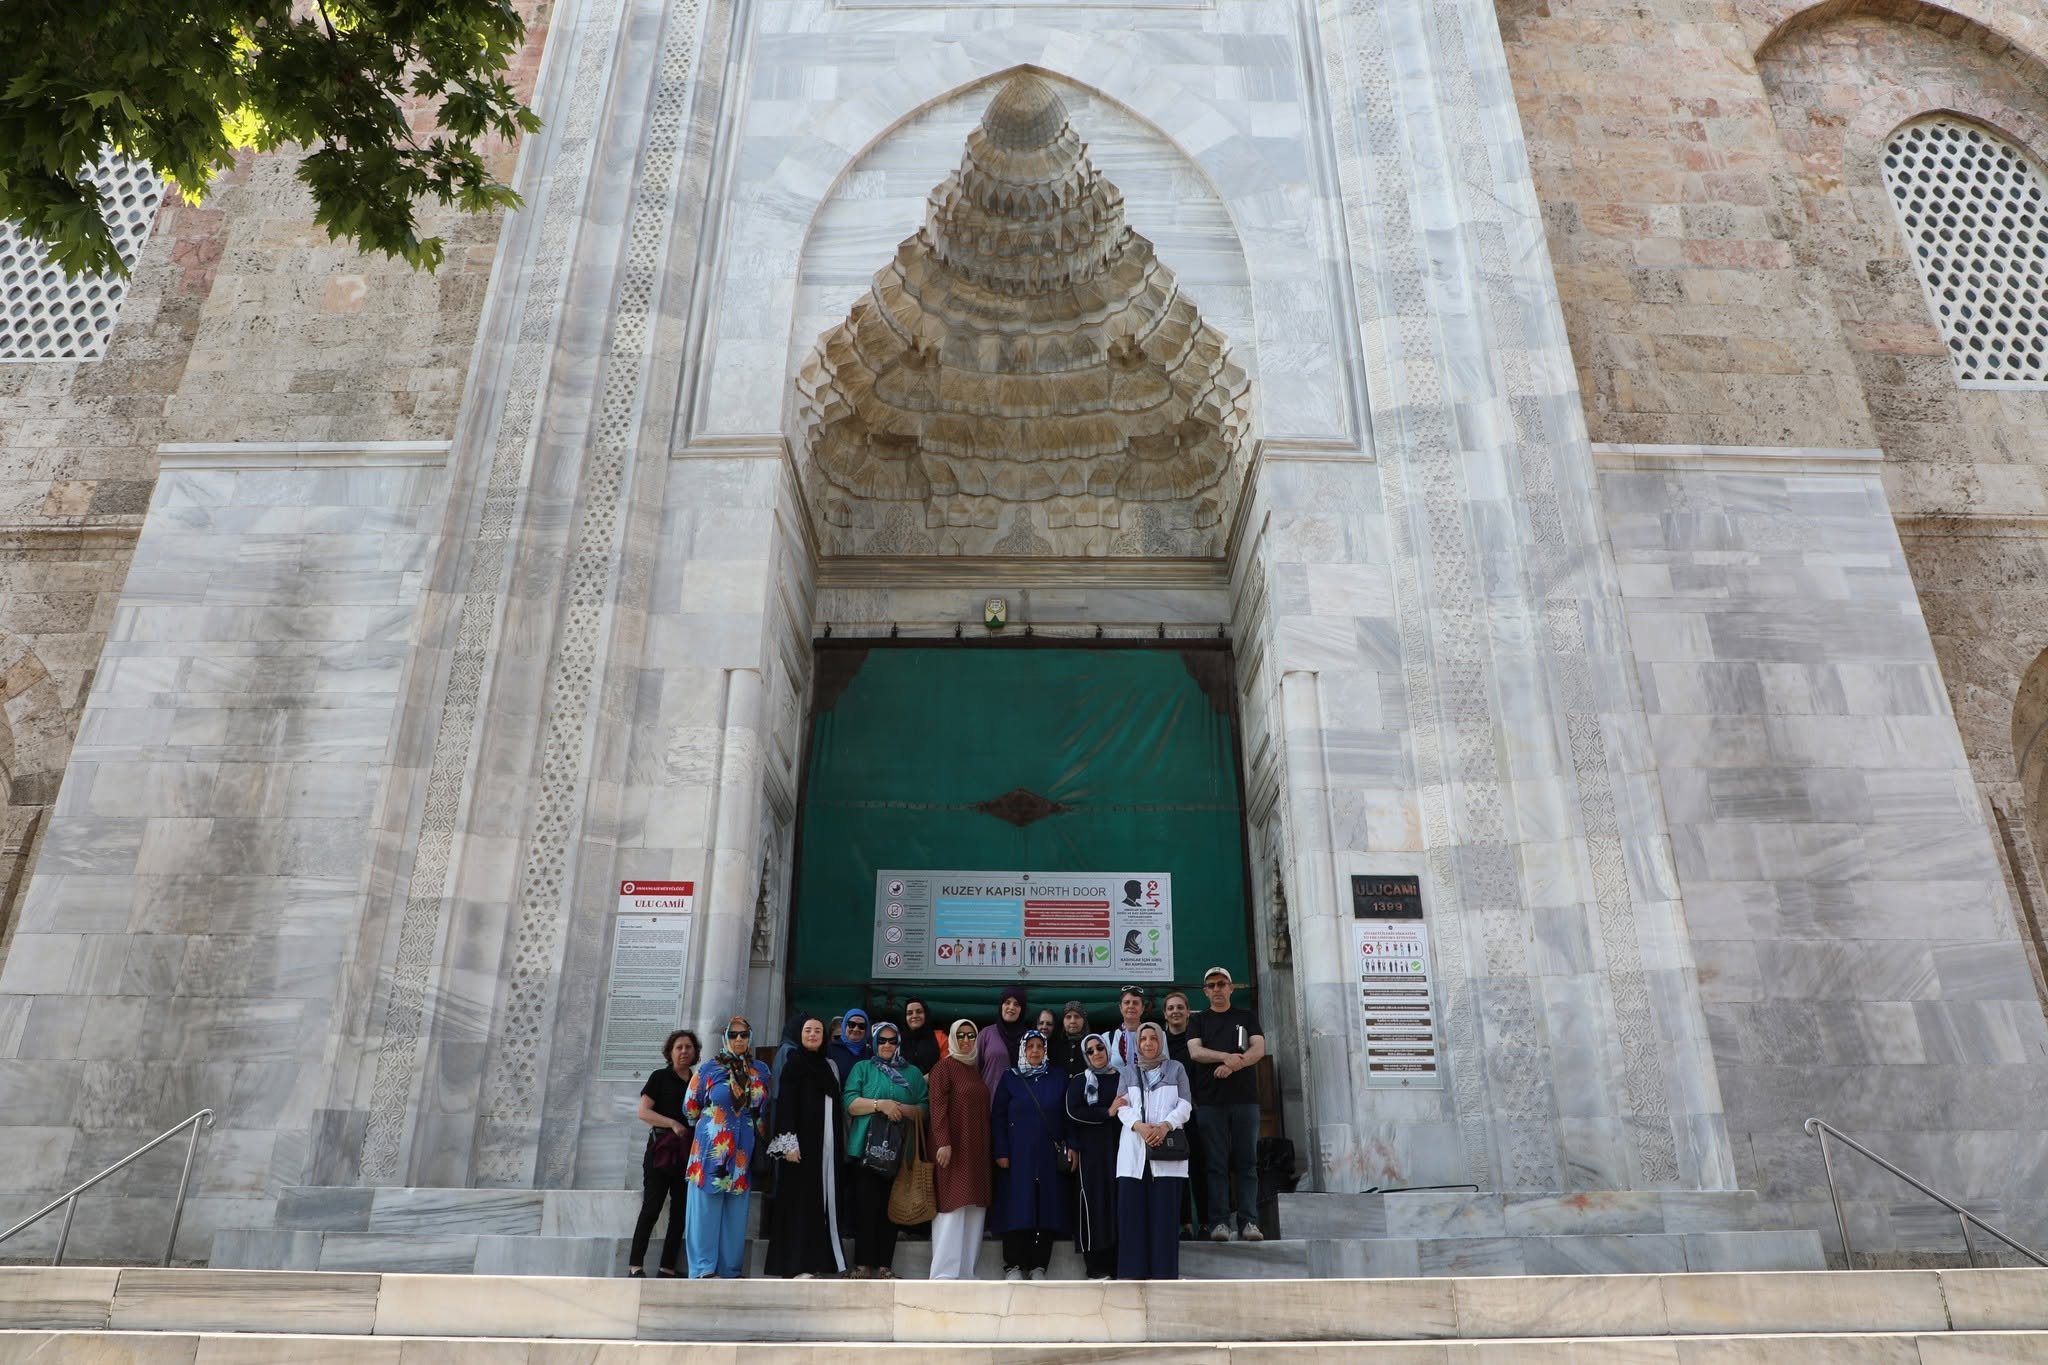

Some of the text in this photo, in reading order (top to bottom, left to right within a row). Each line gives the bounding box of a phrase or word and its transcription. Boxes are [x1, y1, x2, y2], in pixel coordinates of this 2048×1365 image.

[942, 886, 1106, 897] KUZEY KAPISI NORTH DOOR
[635, 898, 684, 908] ULU CAMİİ
[1373, 902, 1403, 912] 1399
